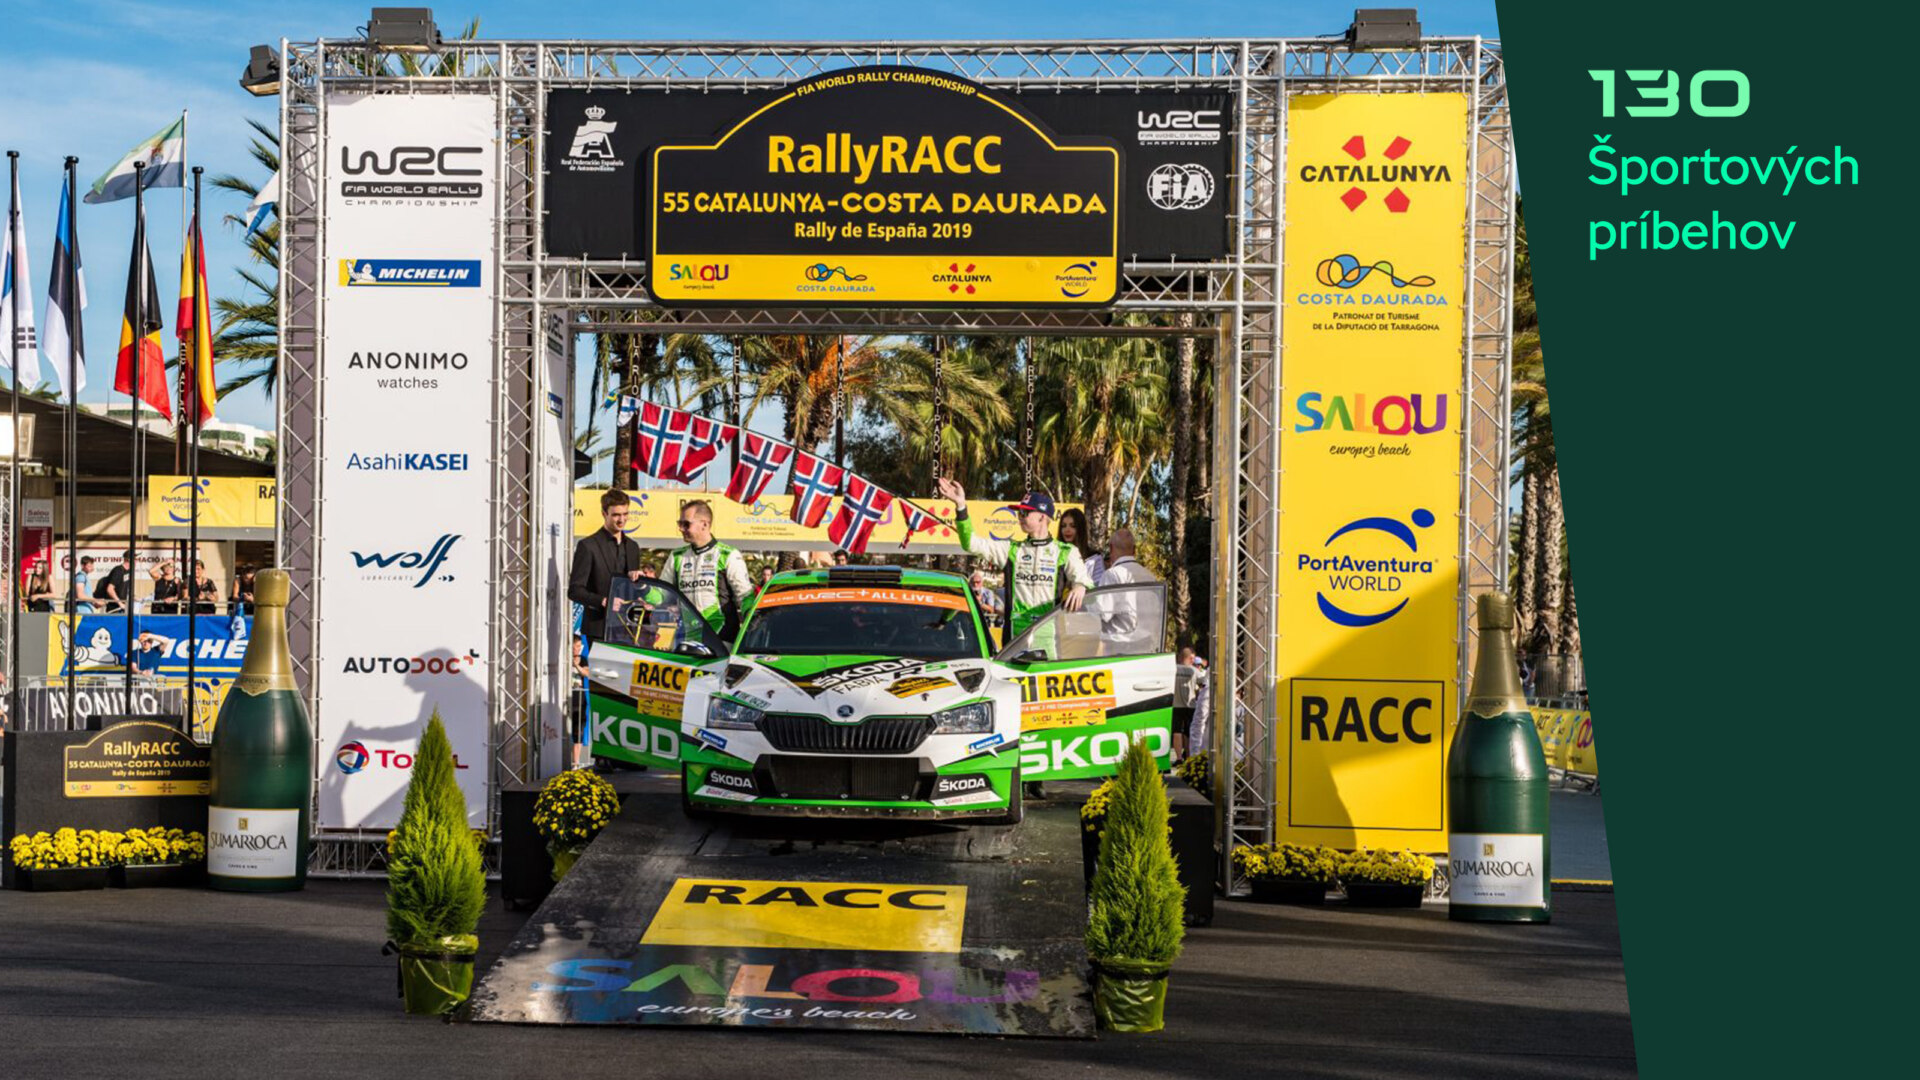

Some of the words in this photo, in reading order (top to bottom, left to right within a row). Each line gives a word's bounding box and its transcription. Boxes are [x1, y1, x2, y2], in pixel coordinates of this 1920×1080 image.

[797, 84, 816, 97] FIA
[816, 74, 856, 90] WORLD
[857, 72, 890, 84] RALLY
[892, 72, 976, 97] CHAMPIONSHIP
[1138, 110, 1221, 129] WRC
[341, 145, 484, 176] WRC
[768, 132, 1002, 185] RallyRACC
[1299, 164, 1452, 183] CATALUNYA
[344, 185, 367, 193] FIA
[370, 185, 424, 194] WORLD
[427, 185, 479, 194] RALLY
[663, 192, 690, 213] 55
[952, 193, 1107, 214] DAURADA
[795, 221, 837, 242] Rally
[841, 221, 862, 238] de
[867, 222, 927, 242] España
[932, 222, 973, 239] 2019
[378, 268, 470, 280] MICHELIN
[669, 264, 729, 281] SALOU
[932, 274, 992, 283] CATALUNYA
[796, 284, 827, 292] COSTA
[829, 285, 875, 293] DAURADA
[1297, 293, 1356, 305] COSTA
[1361, 293, 1448, 306] DAURADA
[1375, 313, 1386, 321] DE
[1312, 323, 1322, 331] DE
[1324, 323, 1334, 331] LA
[1379, 323, 1389, 331] DE
[347, 351, 469, 370] ANONIMO
[377, 376, 439, 389] watches
[1294, 391, 1448, 436] SALOU
[1329, 443, 1376, 458] europe's
[1377, 443, 1412, 457] beach
[1298, 554, 1433, 573] PortAventura
[1329, 576, 1402, 592] WORLD
[871, 592, 898, 600] ALL
[902, 593, 934, 603] LIVE
[342, 657, 461, 675] AUTODOC
[811, 658, 928, 689] ŠKODA
[637, 661, 684, 691] RACC
[1045, 671, 1107, 699] RACC
[831, 675, 890, 696] FABIA
[1300, 695, 1432, 744] RACC
[103, 741, 180, 758] RallyRACC
[69, 760, 80, 768] 55
[710, 769, 753, 789] ŠKODA
[938, 778, 986, 792] ŠKODA
[209, 831, 288, 851] SUMARROCA
[1452, 860, 1535, 878] SUMARROCA
[684, 884, 948, 911] RACC
[637, 1003, 796, 1021] europe's
[802, 1004, 918, 1021] beach
